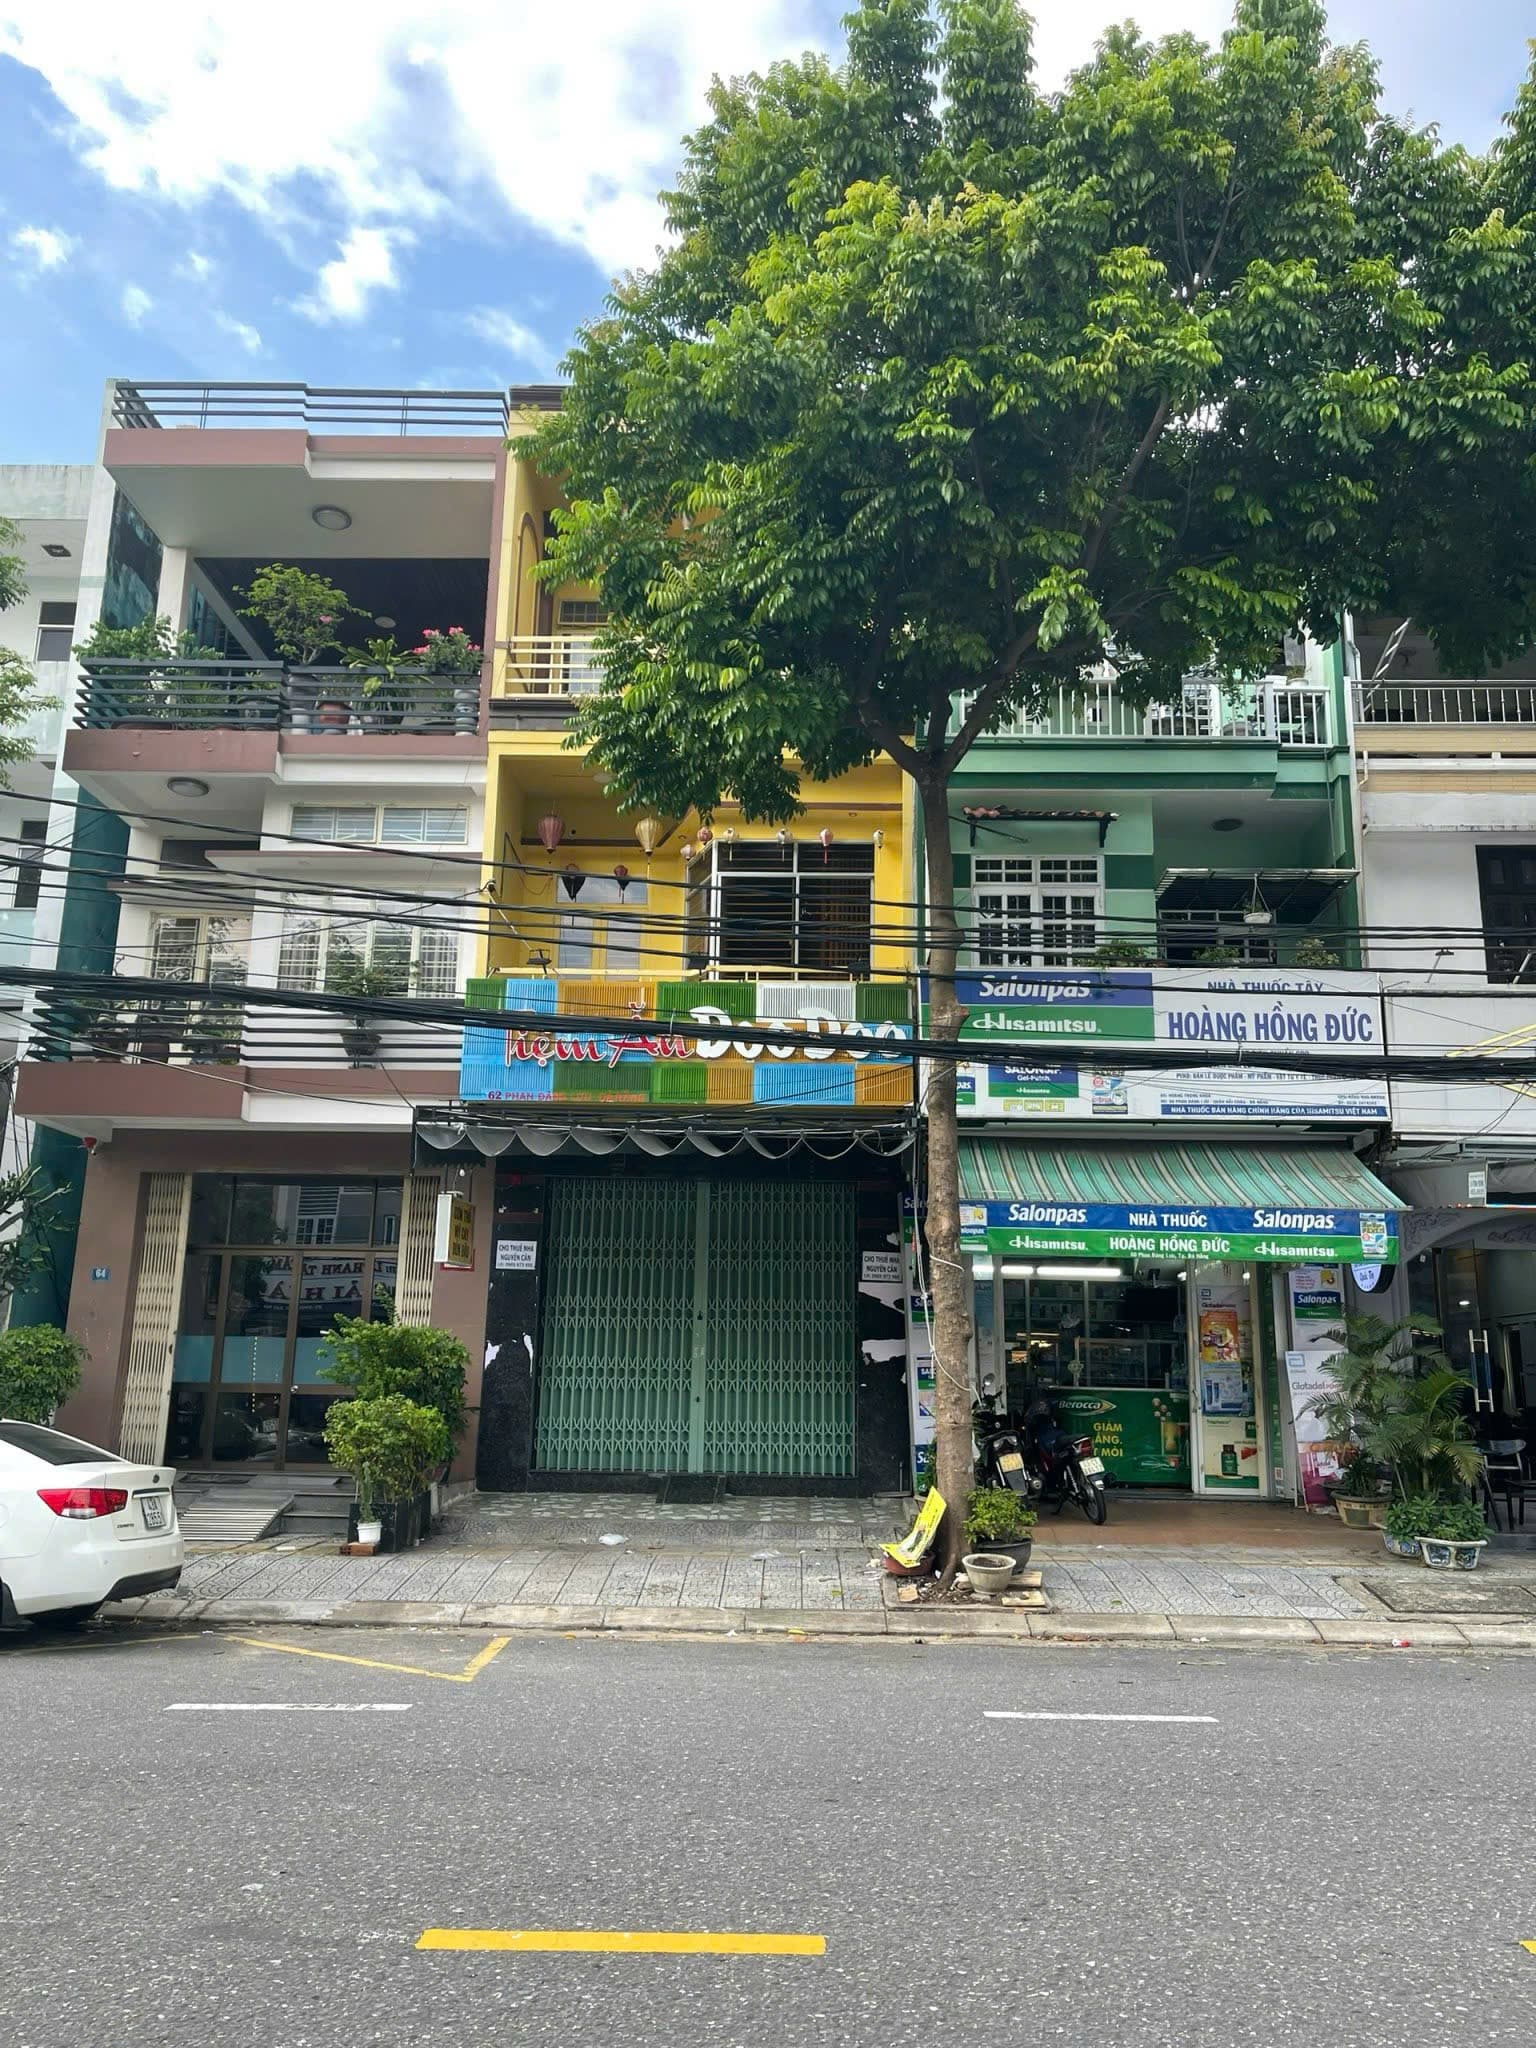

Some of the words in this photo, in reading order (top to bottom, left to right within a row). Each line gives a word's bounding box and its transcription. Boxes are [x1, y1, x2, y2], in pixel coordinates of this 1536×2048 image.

[980, 975, 1090, 1002] Salonpas
[1168, 1004, 1247, 1041] HOÀNG
[1254, 1000, 1318, 1042] HỒNG
[1324, 1006, 1373, 1042] ĐỨC
[487, 1091, 502, 1101] 62
[1008, 1204, 1087, 1226] Salonpas
[1129, 1210, 1157, 1226] NHÀ
[1161, 1210, 1207, 1227] THUỐC
[1253, 1210, 1335, 1232] Salonpas
[1109, 1234, 1155, 1250] HOÀNG
[1160, 1234, 1197, 1252] HỒNG
[1202, 1237, 1230, 1252] ĐỨC
[95, 1268, 106, 1278] 64
[1058, 1400, 1101, 1409] Berocca
